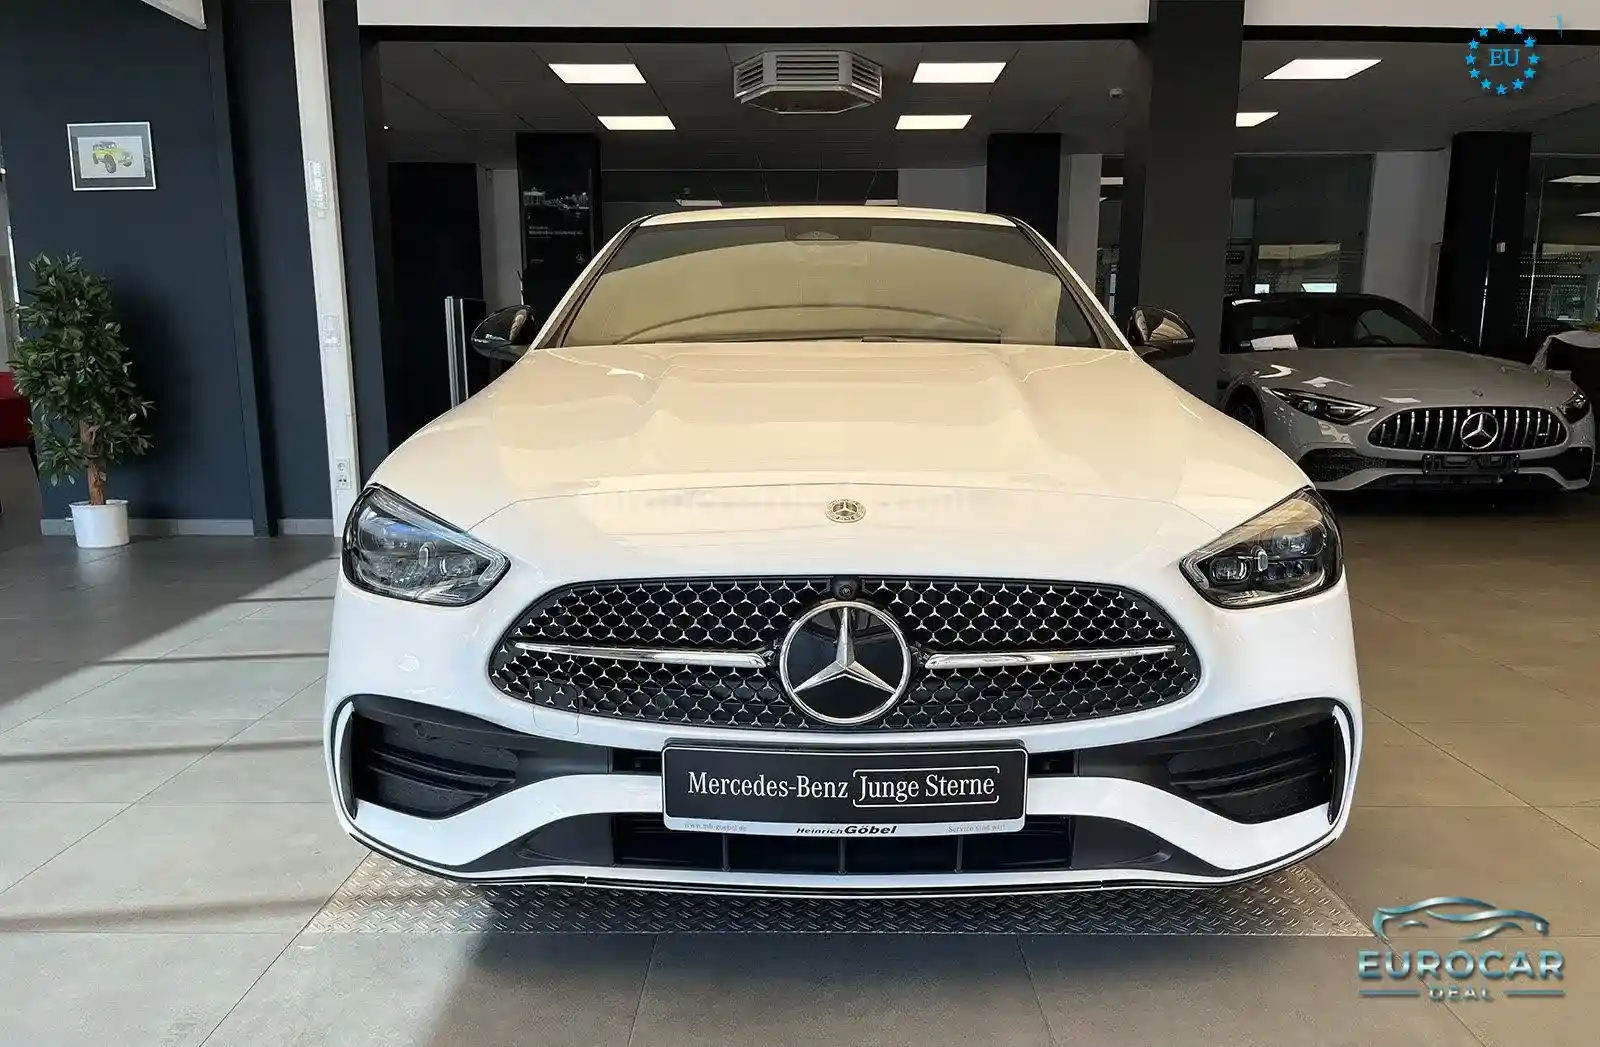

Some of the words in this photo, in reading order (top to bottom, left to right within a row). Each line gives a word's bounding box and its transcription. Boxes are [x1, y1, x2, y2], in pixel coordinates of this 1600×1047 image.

[687, 771, 849, 798] Mercedes-Benz
[859, 775, 919, 802] Junge
[925, 773, 995, 797] Sterne
